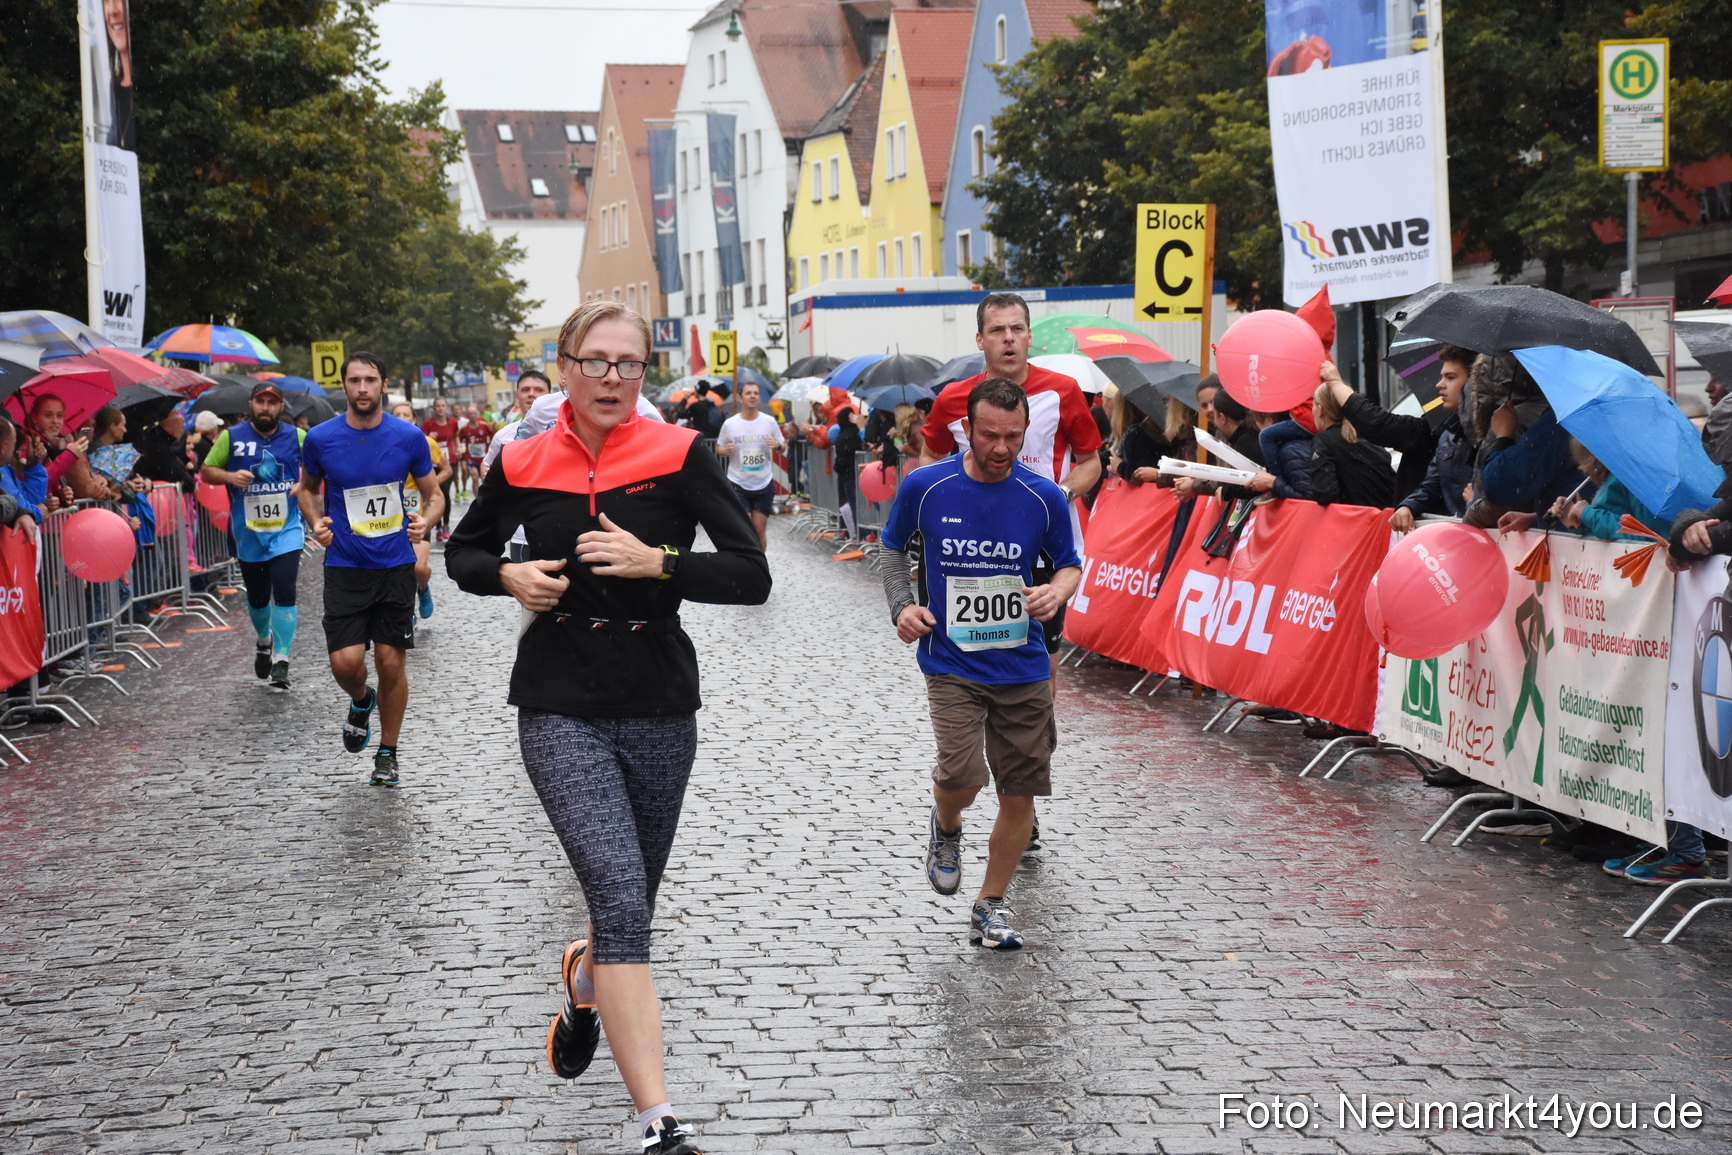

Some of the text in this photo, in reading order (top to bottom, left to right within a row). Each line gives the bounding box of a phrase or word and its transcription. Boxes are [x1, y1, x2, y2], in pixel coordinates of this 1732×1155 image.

[1613, 105, 1655, 114] Marktplatz
[1146, 209, 1206, 230] Block
[1155, 239, 1194, 297] C
[712, 332, 734, 341] Block
[315, 344, 340, 352] Block
[717, 344, 730, 366] D
[320, 356, 337, 378] D
[233, 441, 257, 457] 21
[742, 454, 765, 466] 2865
[242, 482, 295, 493] FIBALON
[625, 483, 650, 495] CRAFT
[253, 503, 281, 519] 194
[365, 496, 388, 517] 47
[369, 521, 390, 531] Peter
[942, 538, 1022, 560] SYSCAD
[984, 577, 1023, 589] BOCK
[1412, 542, 1460, 604] RÖDL
[1428, 576, 1452, 607] energie
[956, 591, 1023, 623] 2906
[1595, 600, 1606, 622] 52
[968, 629, 1010, 641] Thomas
[1559, 684, 1644, 737] Gebäudereinigung
[1558, 726, 1645, 774] Hausmeisterdienst
[1559, 768, 1653, 822] Arbeitsbühnenverleih
